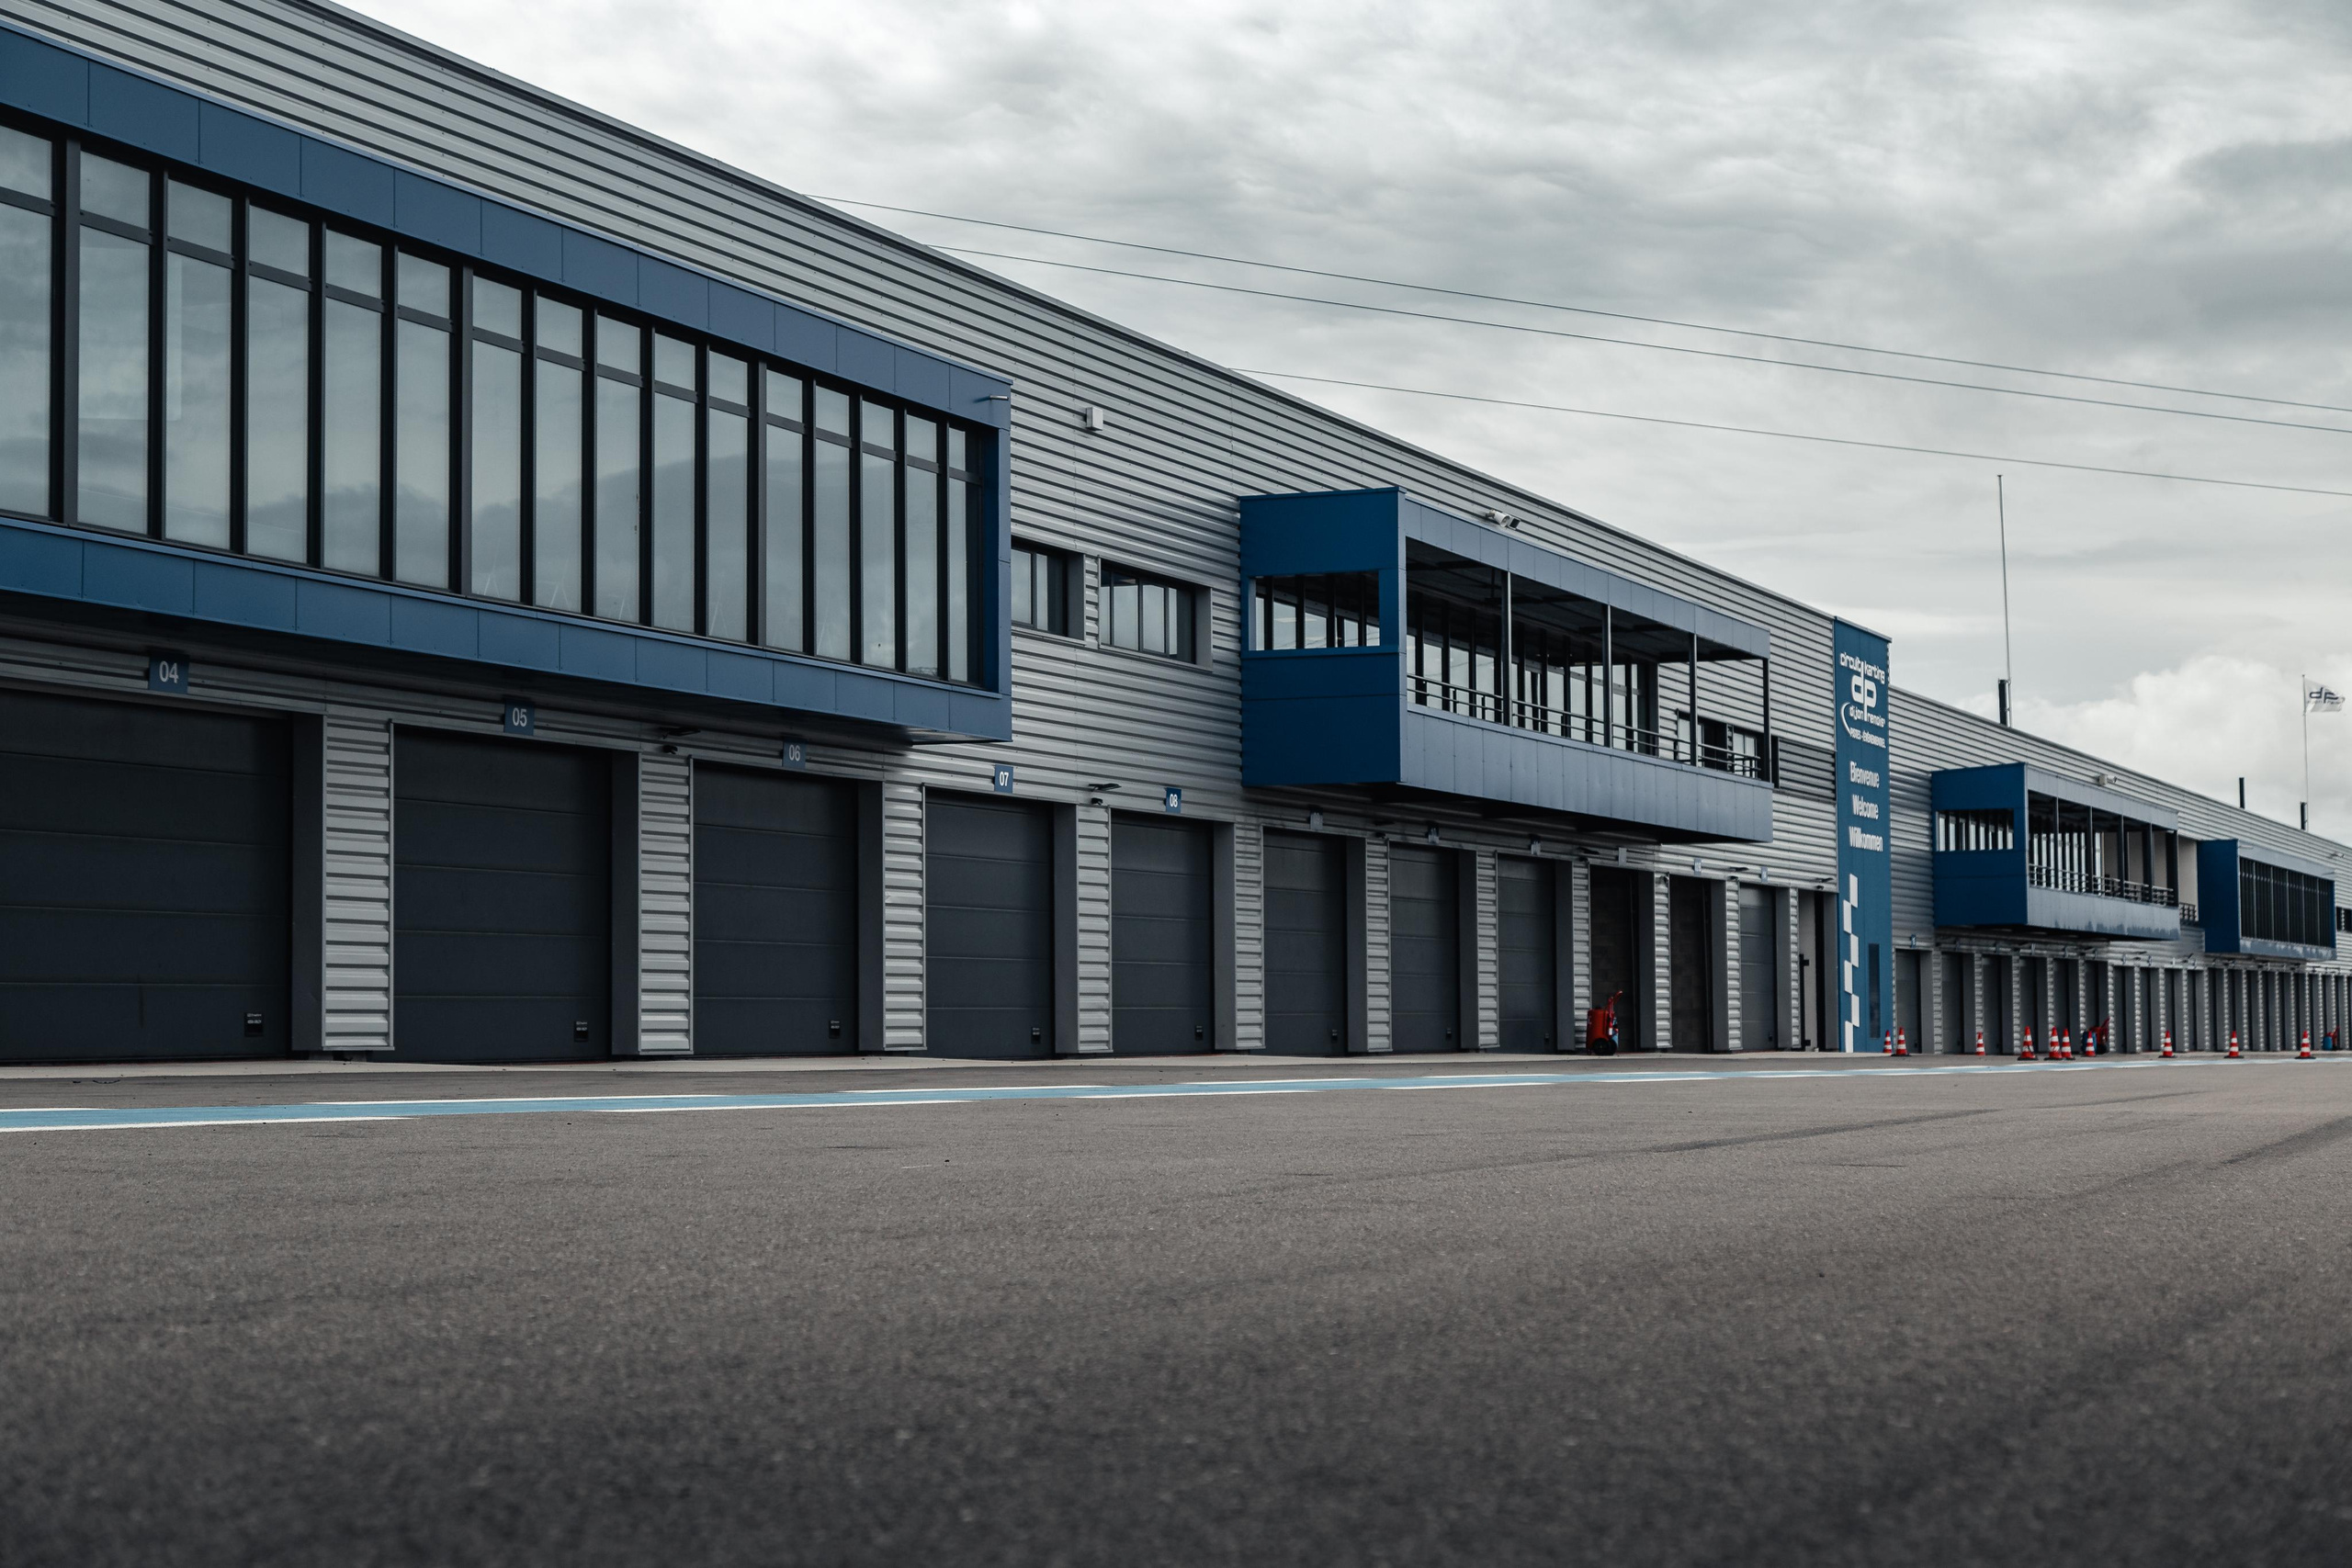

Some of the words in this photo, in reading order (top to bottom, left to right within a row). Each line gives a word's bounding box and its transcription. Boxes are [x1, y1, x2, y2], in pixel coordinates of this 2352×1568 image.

[159, 660, 179, 684] 04
[1864, 660, 1885, 684] karting
[512, 707, 527, 728] 05
[788, 744, 801, 761] 06
[999, 771, 1010, 787] 07
[1849, 761, 1880, 788] Bienvenue
[1170, 793, 1178, 808] 08
[1852, 794, 1879, 819] Welcome
[1849, 826, 1883, 852] Willkommen
